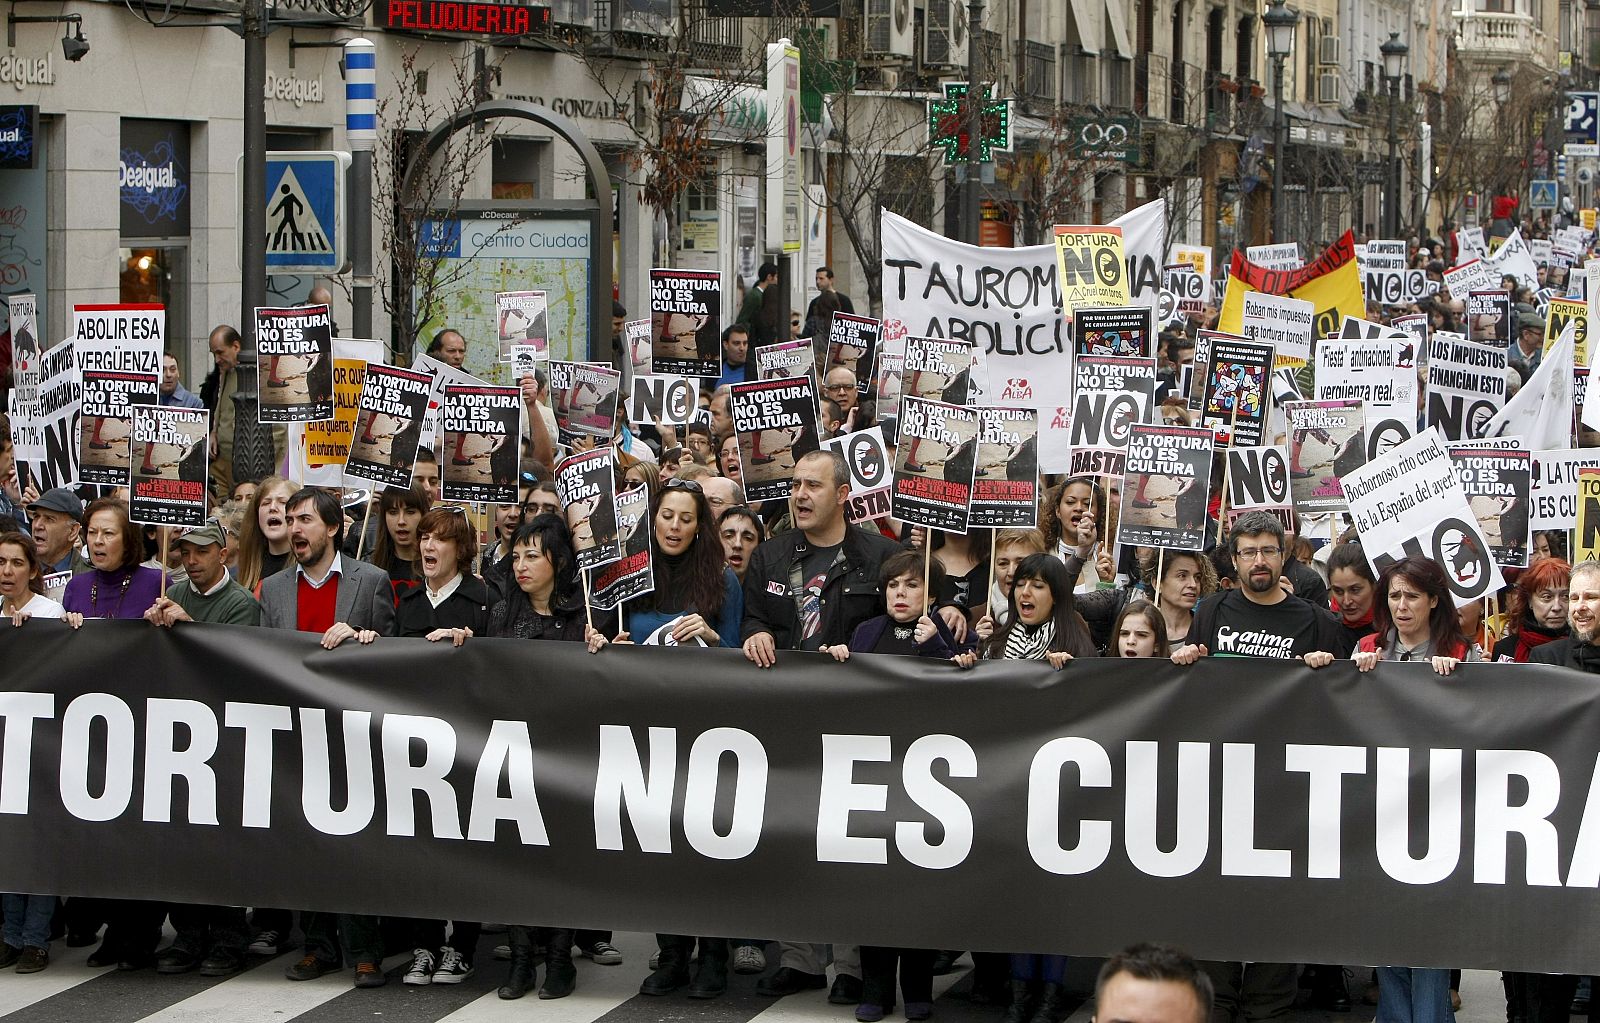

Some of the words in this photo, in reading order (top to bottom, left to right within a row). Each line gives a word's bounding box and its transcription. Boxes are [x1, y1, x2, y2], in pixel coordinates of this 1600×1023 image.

[388, 2, 529, 34] PELUQUERIA
[265, 71, 323, 107] Desigual
[119, 160, 174, 193] Desigual
[480, 211, 519, 219] JCDecaux
[472, 232, 525, 248] Centro
[530, 232, 588, 248] Ciudad
[1059, 235, 1119, 248] TORTURA
[1368, 243, 1377, 254] LOS
[1063, 247, 1121, 286] NO
[1392, 259, 1404, 269] ESTO
[1468, 264, 1482, 276] ESA
[652, 280, 663, 288] LA
[664, 278, 720, 291] TORTURA
[1171, 273, 1204, 298] NO
[1367, 272, 1403, 303] NO
[652, 288, 671, 300] NO
[676, 289, 693, 301] ES
[1082, 287, 1098, 298] Cruel
[1099, 288, 1108, 296] con
[1476, 294, 1509, 302] TORTURA
[652, 300, 708, 314] CULTURA
[1177, 300, 1203, 312] ASTA!
[1246, 300, 1266, 316] Roban
[1267, 304, 1278, 318] mis
[1279, 305, 1311, 324] impuestos
[77, 316, 127, 341] ABOLIR
[131, 316, 161, 341] ESA
[259, 319, 270, 329] LA
[272, 314, 329, 329] TORTURA
[842, 320, 877, 333] TORTURA
[259, 329, 279, 341] NO
[284, 329, 304, 342] ES
[832, 326, 844, 335] NO
[847, 329, 859, 338] ES
[1244, 326, 1259, 337] para
[1260, 326, 1286, 340] torturar
[1286, 330, 1310, 346] toros!!!
[259, 340, 320, 354] CULTURA
[831, 335, 868, 348] CULTURA
[907, 339, 920, 350] LA
[922, 341, 969, 355] TORTURA
[906, 349, 925, 362] NO
[930, 351, 943, 363] ES
[1321, 343, 1348, 368] "Fiesta"
[1351, 344, 1395, 369] antinacional,
[1431, 340, 1449, 361] LOS
[905, 360, 956, 374] CULTURA
[1078, 366, 1091, 375] LA
[1093, 365, 1155, 379] TORTURA
[84, 382, 95, 391] LA
[98, 380, 157, 395] TORTURA
[366, 374, 375, 384] LA
[378, 373, 430, 395] TORTURA
[1077, 376, 1100, 388] NO
[1105, 377, 1125, 389] ES
[1373, 379, 1395, 400] real.
[1480, 376, 1504, 396] ESTO
[84, 390, 106, 403] NO
[110, 392, 129, 405] ES
[364, 384, 383, 398] NO
[385, 390, 401, 402] ES
[633, 379, 694, 422] NO
[733, 396, 746, 406] LA
[747, 385, 812, 403] TORTURA
[362, 398, 413, 418] CULTURA
[445, 397, 457, 405] LA
[458, 395, 520, 408] TORTURA
[135, 409, 149, 420] LA
[152, 410, 204, 424] TORTURA
[445, 407, 466, 419] NO
[471, 407, 490, 420] ES
[735, 404, 758, 419] NO
[763, 402, 783, 415] ES
[906, 401, 920, 412] LA
[922, 402, 974, 422] TORTURA
[135, 419, 155, 431] NO
[159, 421, 177, 433] ES
[445, 419, 506, 433] CULTURA
[737, 412, 802, 431] CULTURA
[905, 411, 923, 426] NO
[927, 415, 945, 429] ES
[986, 421, 1004, 432] ES
[1070, 394, 1140, 446] NO
[1292, 419, 1306, 428] 28
[1308, 416, 1346, 428] MARZO
[135, 431, 192, 445] CULTURA
[903, 424, 961, 445] CULTURA
[1130, 436, 1145, 446] LA
[1146, 435, 1212, 450] TORTURA
[310, 445, 317, 456] en
[1129, 447, 1153, 460] NO
[1158, 448, 1179, 461] ES
[560, 456, 612, 481] TORTURA
[1070, 450, 1125, 476] ¡BASTA
[1128, 460, 1195, 475] CULTURA
[1464, 458, 1530, 471] TORTURA
[1229, 449, 1288, 505] NO
[1344, 466, 1400, 503] Bochornoso
[1400, 455, 1415, 475] rito
[1417, 443, 1446, 471] cruel,
[1478, 470, 1499, 483] ES
[1547, 461, 1562, 484] LA
[947, 487, 968, 498] BIEN
[1011, 486, 1033, 494] BIEN
[1463, 481, 1516, 496] ULTURA
[1357, 513, 1369, 534] de
[1370, 507, 1379, 527] la
[1378, 489, 1415, 523] España
[1415, 479, 1429, 503] del
[1430, 467, 1457, 502] ayer!
[1540, 496, 1556, 519] ES
[1239, 630, 1294, 649] anima
[1236, 641, 1292, 659] naturalis
[0, 692, 550, 846] TORTURA
[594, 724, 769, 860] NO
[816, 733, 978, 869] ES
